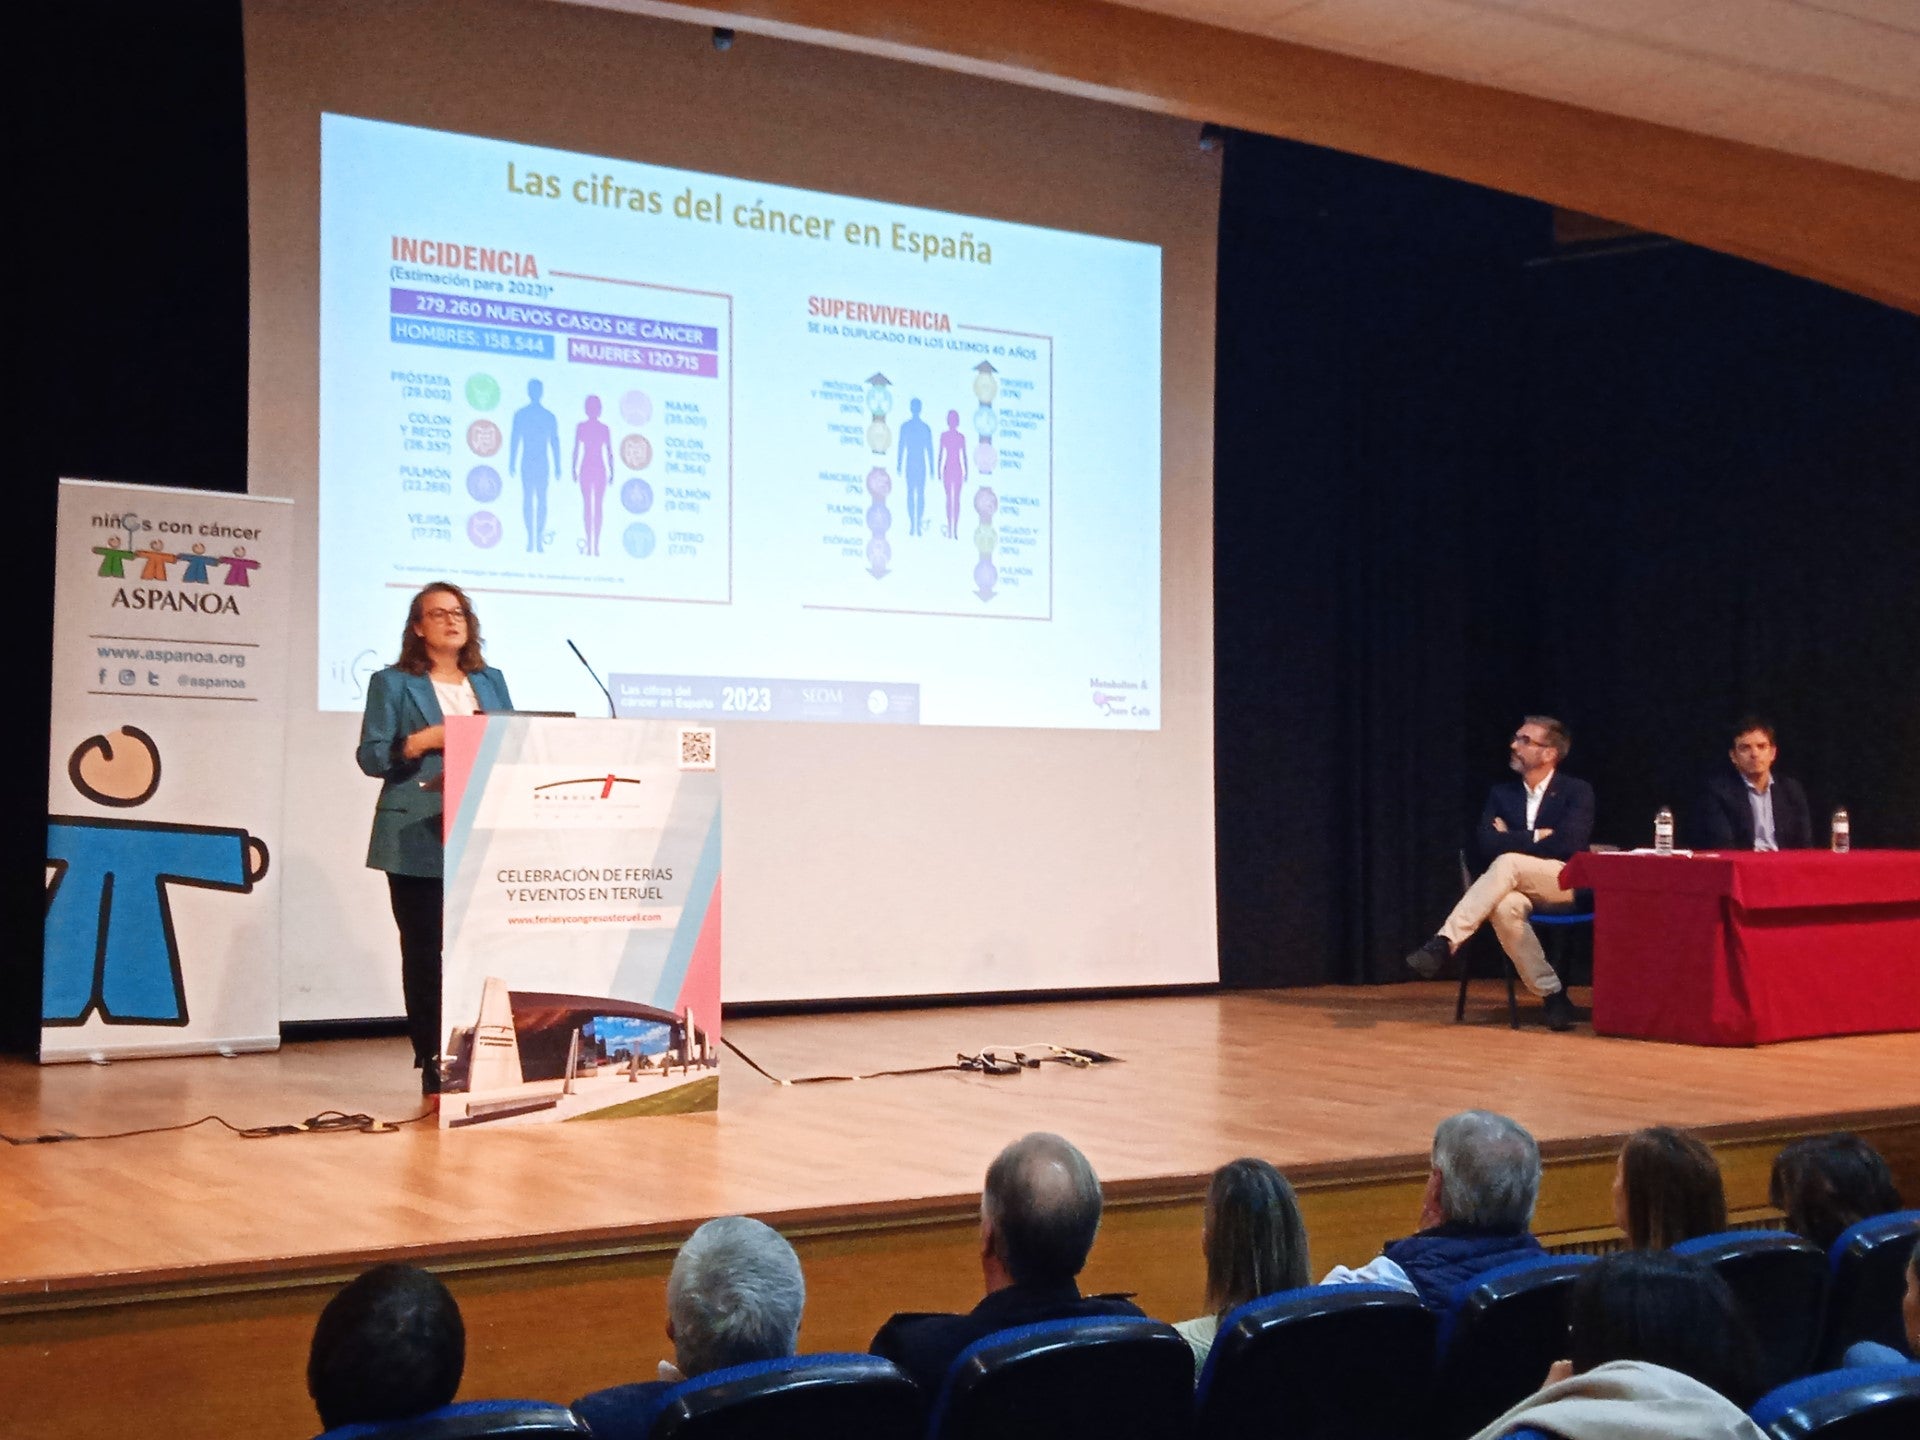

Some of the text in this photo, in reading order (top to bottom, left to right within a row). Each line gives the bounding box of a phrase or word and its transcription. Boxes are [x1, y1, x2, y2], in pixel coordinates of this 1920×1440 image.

[507, 161, 992, 264] Las cifras del cáncer en España
[391, 235, 539, 280] INCIDENCIA
[390, 265, 471, 288] (Estimación
[473, 278, 505, 293] para
[416, 295, 704, 345] 279.260 NUEVOS CASOS DE CÁNCER
[807, 295, 952, 333] SUPERVIVENCIA
[807, 321, 820, 334] SE
[822, 324, 839, 336] HA
[841, 327, 906, 345] DUPLICADO
[908, 334, 923, 347] EN
[158, 520, 192, 534] con
[199, 523, 261, 541] cáncer
[111, 587, 240, 616] ASPANOA
[97, 647, 246, 668] www.aspanoa.org
[722, 686, 772, 713] 2023
[497, 868, 673, 883] CELEBRACIÓN DE FERIAS
[506, 886, 663, 901] Y EVENTOS EN TERUEL
